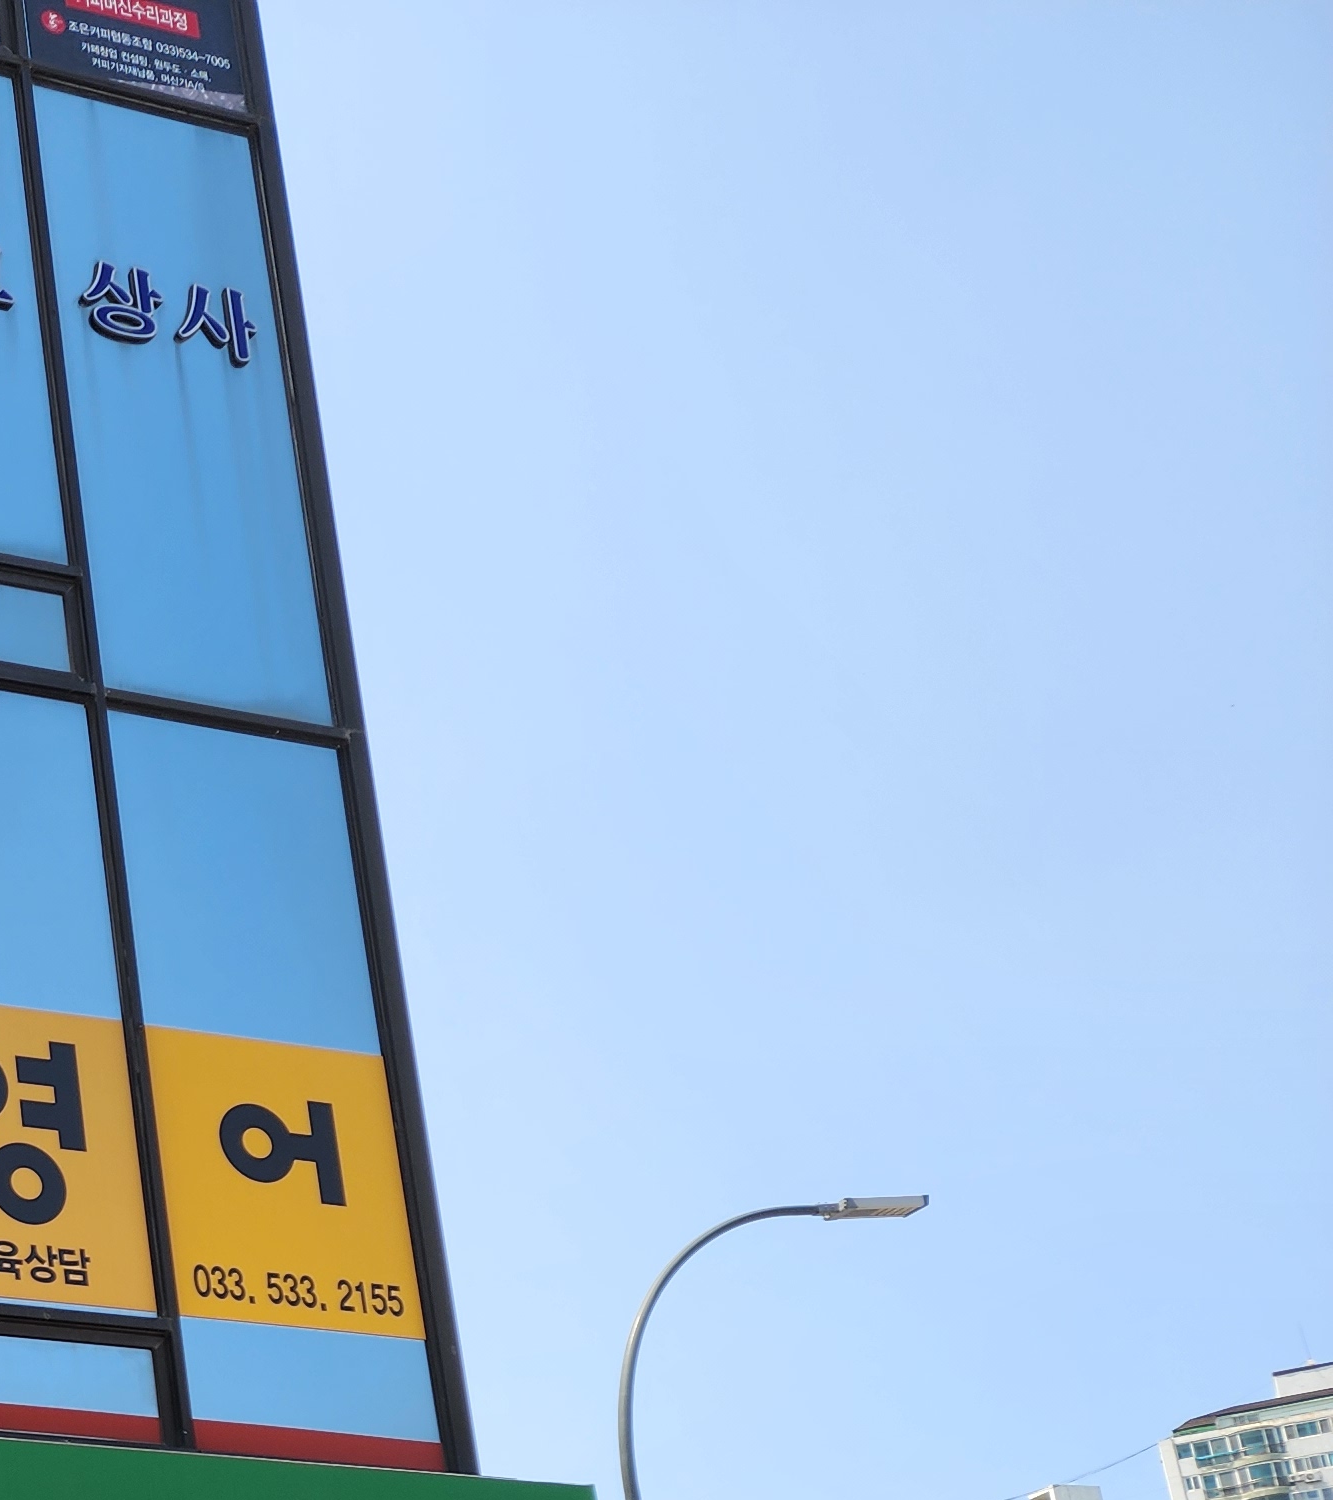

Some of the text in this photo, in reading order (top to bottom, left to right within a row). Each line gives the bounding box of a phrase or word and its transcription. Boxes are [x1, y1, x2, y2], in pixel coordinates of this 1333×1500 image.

[77, 259, 257, 369] 상사
[193, 1263, 405, 1318] 033. 533. 2155
